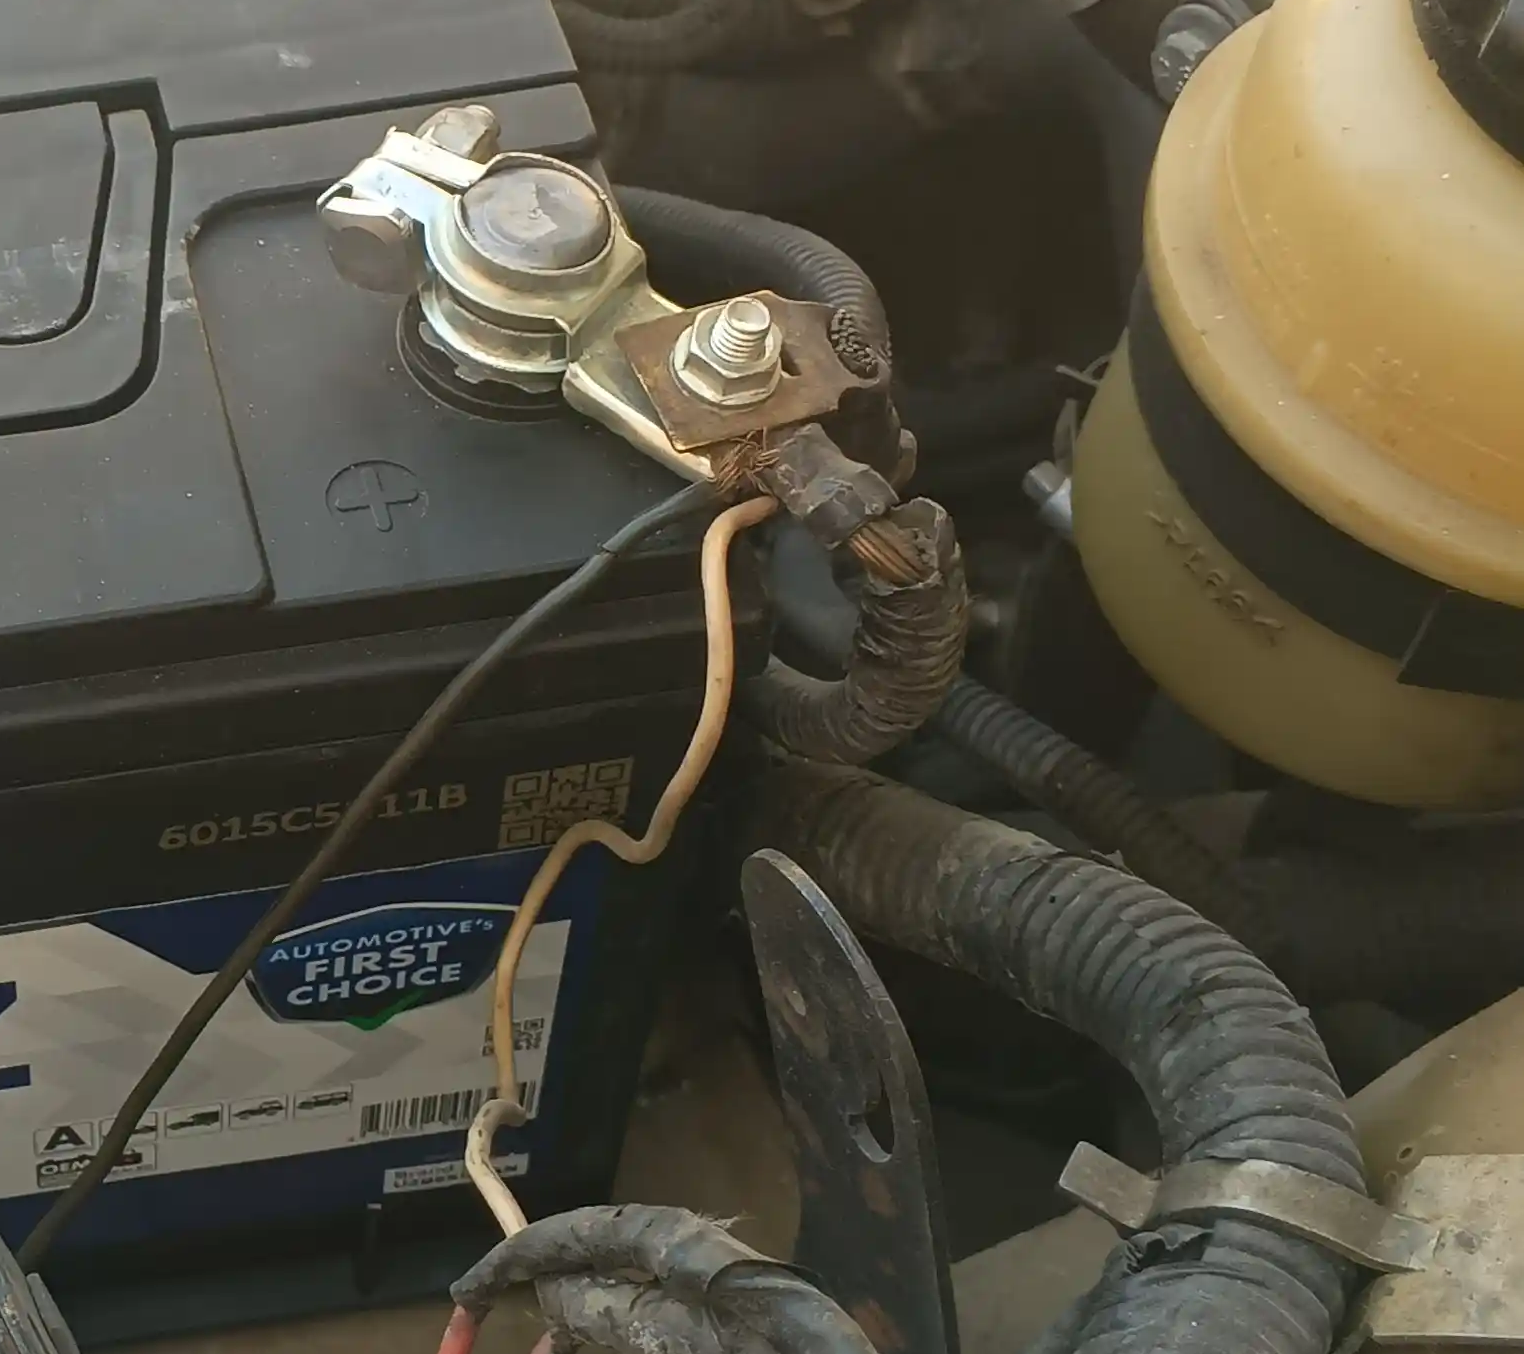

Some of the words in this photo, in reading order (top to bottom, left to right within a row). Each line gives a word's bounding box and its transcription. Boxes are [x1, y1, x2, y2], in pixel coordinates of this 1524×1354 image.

[158, 783, 468, 851] 6015C511B
[305, 941, 448, 982] FIRST
[287, 962, 462, 1006] CHOICE
[43, 1126, 86, 1150] A
